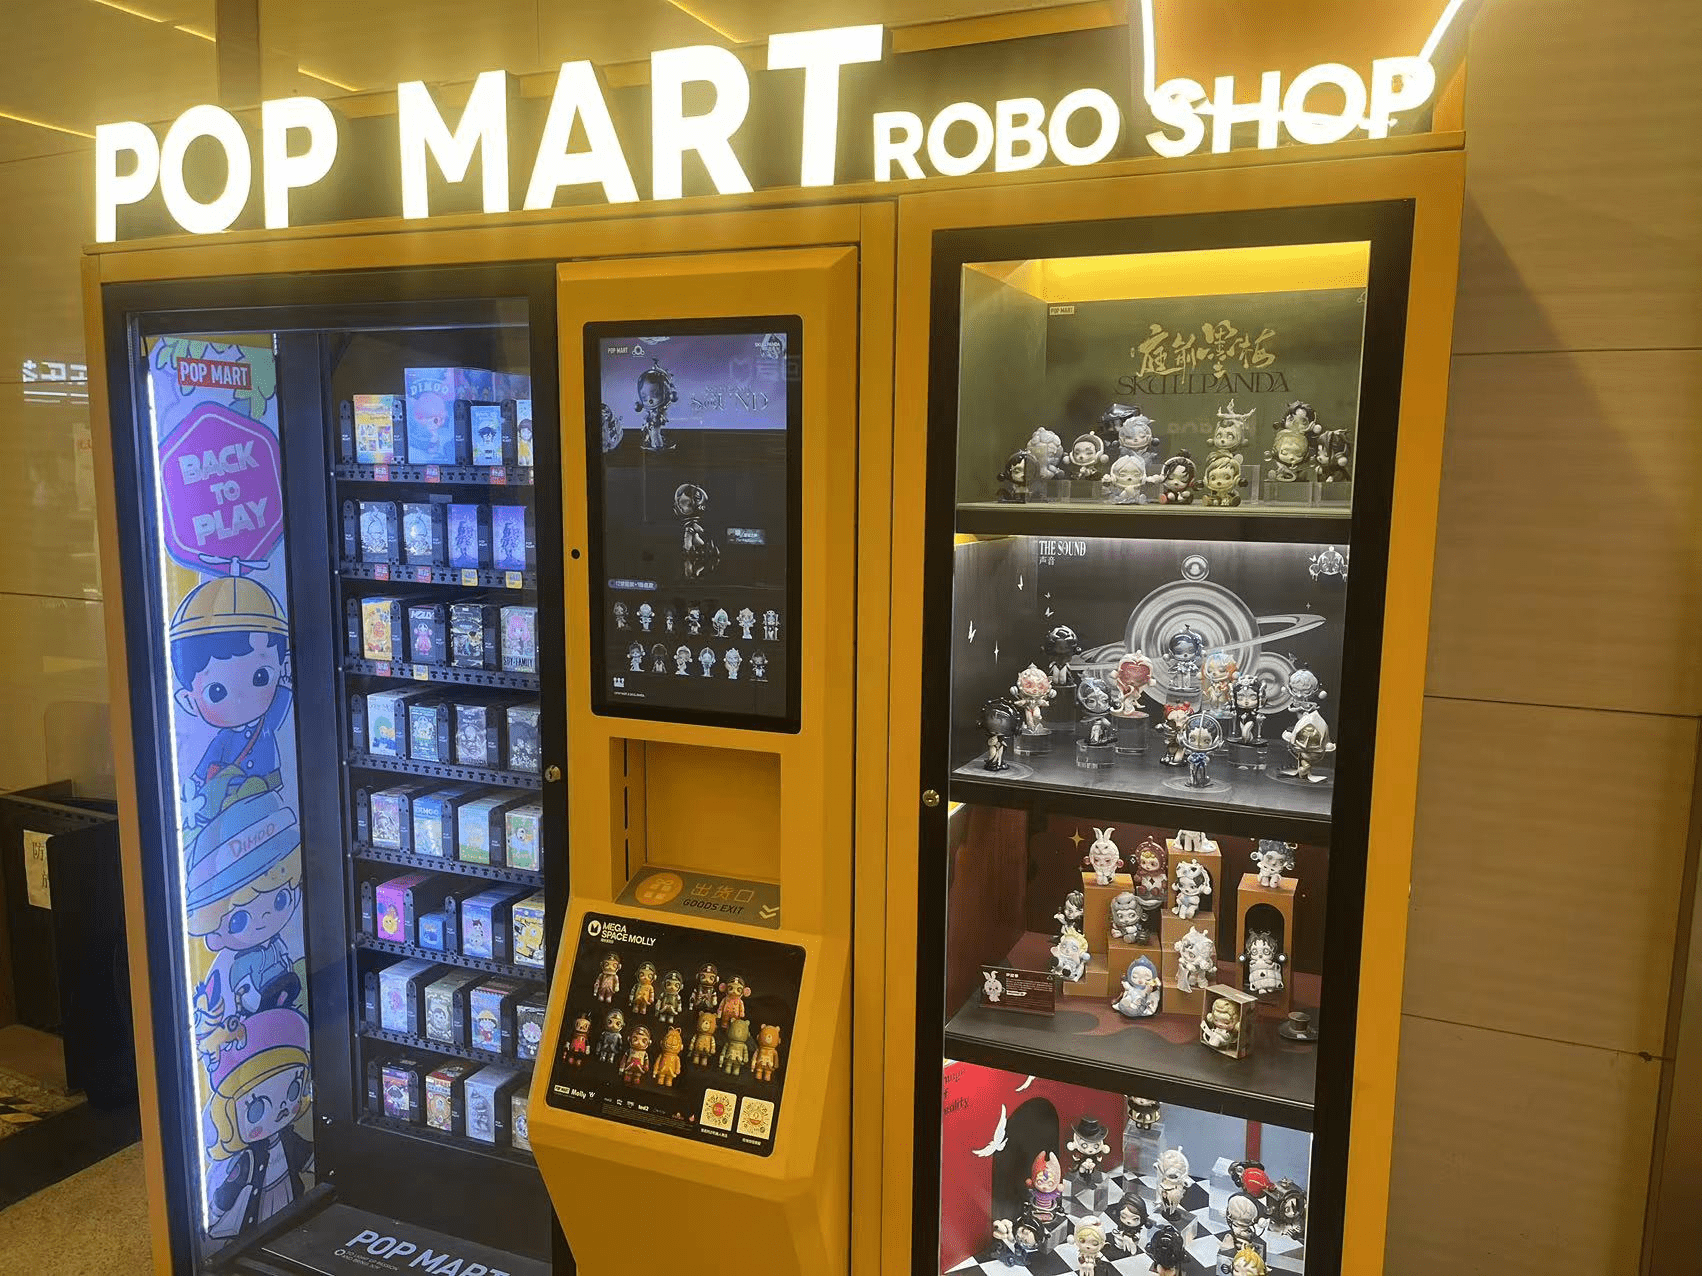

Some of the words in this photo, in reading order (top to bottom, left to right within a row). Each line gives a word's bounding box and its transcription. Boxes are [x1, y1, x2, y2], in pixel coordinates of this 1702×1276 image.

[95, 96, 338, 242] POP
[398, 24, 883, 219] MART
[872, 88, 1120, 183] ROBO
[1145, 56, 1436, 158] SHOP
[180, 361, 207, 383] POP
[211, 365, 248, 386] MART
[178, 440, 259, 485] BACK
[210, 480, 240, 504] TO
[192, 497, 268, 545] PLAY
[1039, 540, 1056, 555] THE
[1057, 541, 1086, 556] SOUND
[690, 882, 755, 903] 出货口
[683, 898, 719, 911] GOODS
[720, 904, 744, 914] EXIT
[601, 930, 628, 942] SPACE
[628, 934, 656, 946] MOLLY
[602, 921, 627, 934] MEGA
[345, 1230, 417, 1259] POP
